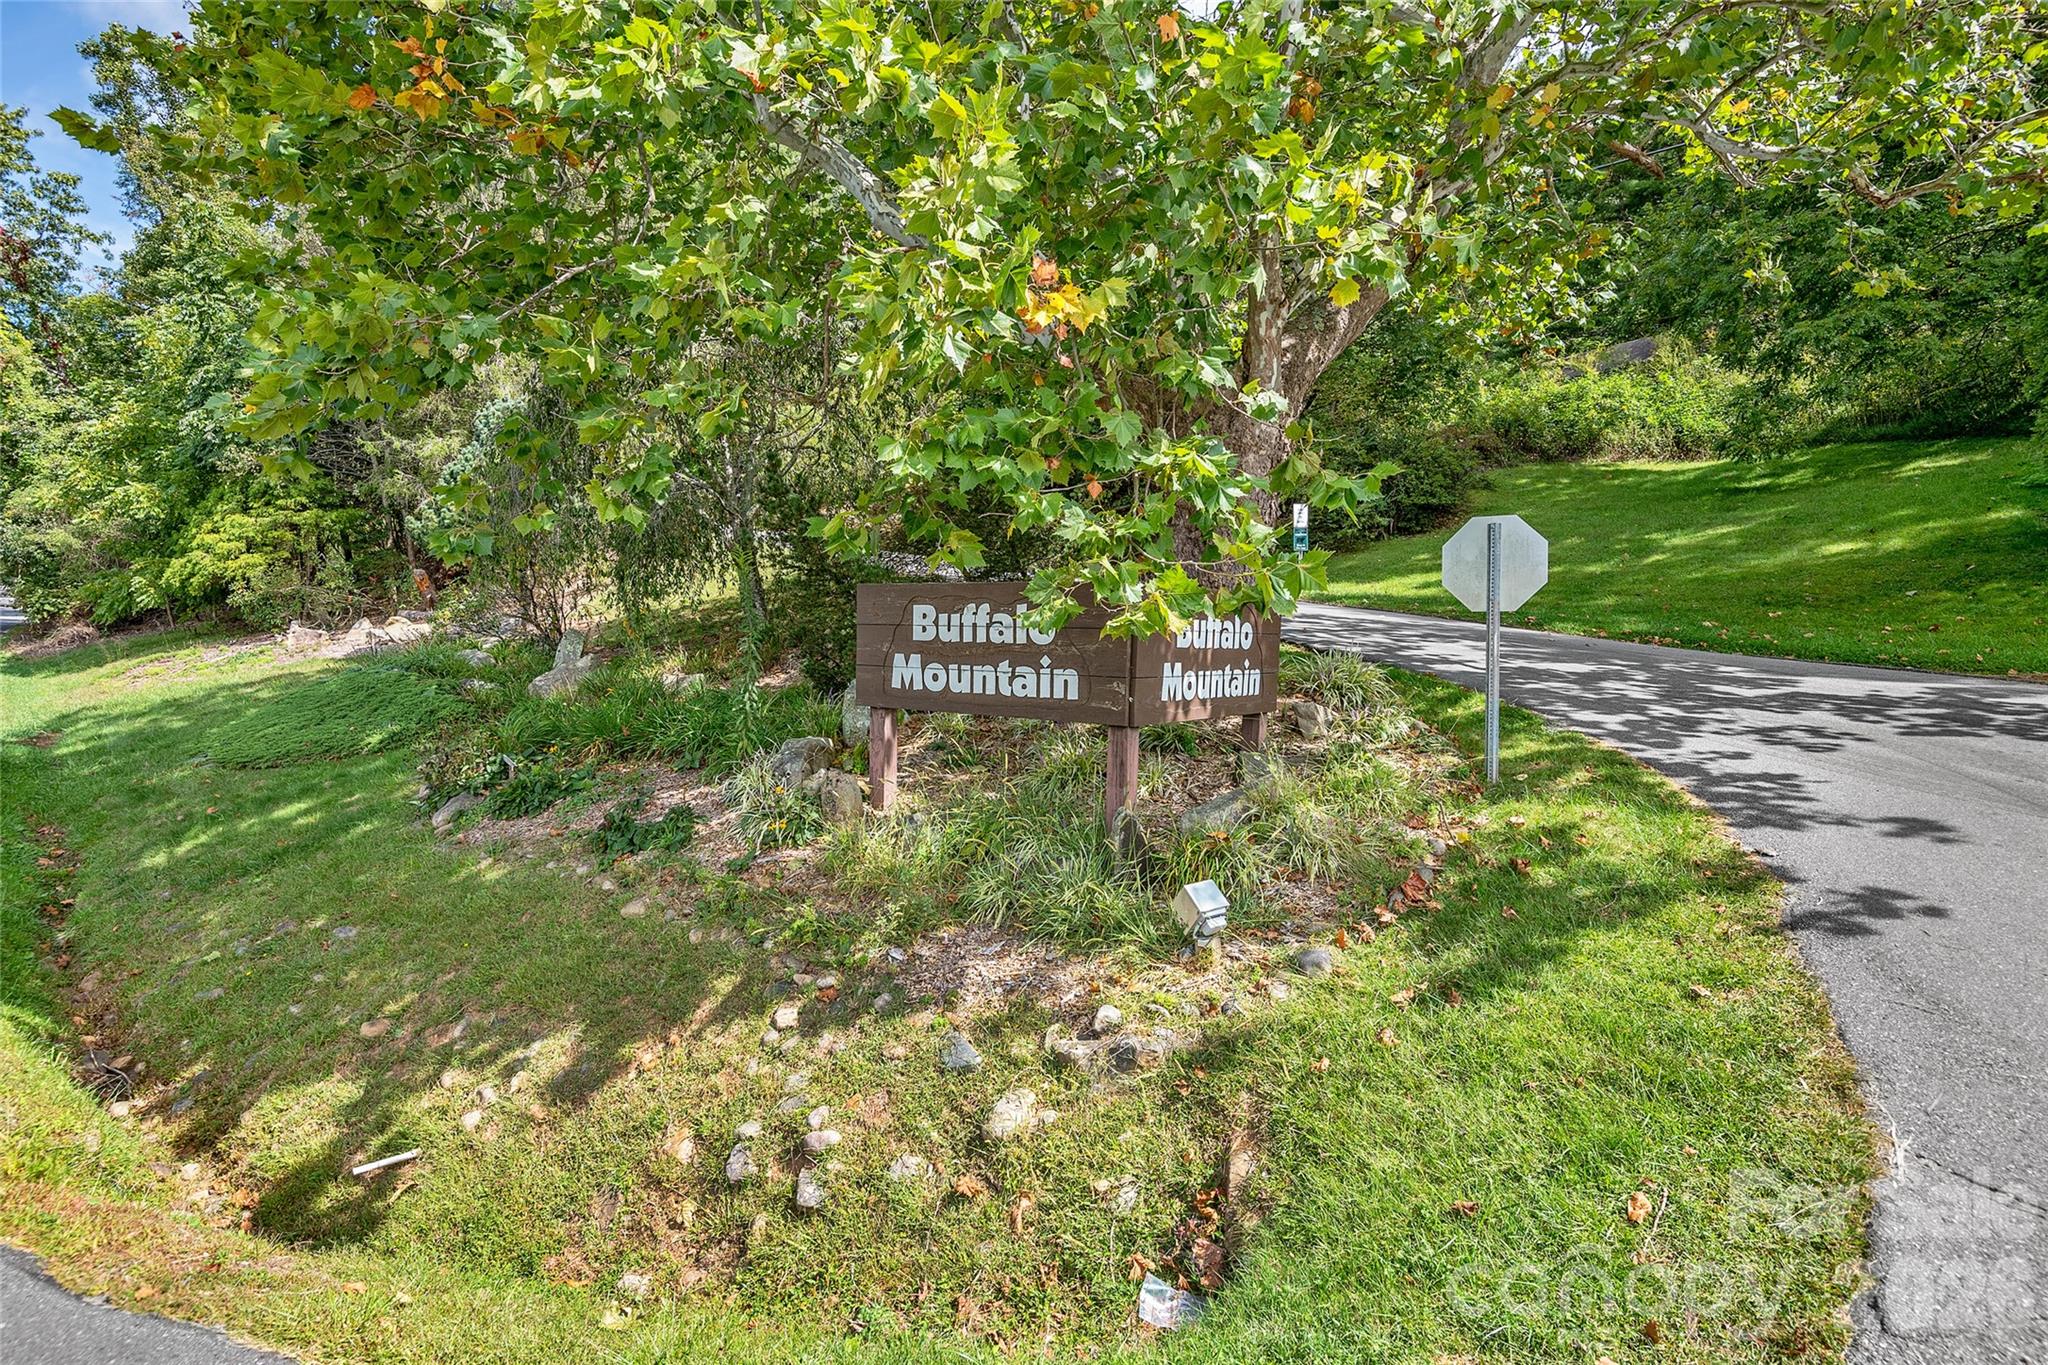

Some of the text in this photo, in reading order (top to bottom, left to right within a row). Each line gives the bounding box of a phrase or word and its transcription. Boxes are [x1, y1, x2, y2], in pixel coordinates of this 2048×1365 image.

[912, 603, 1056, 645] Buffalo
[890, 653, 1079, 700] Mountain
[1160, 658, 1261, 702] Mountain
